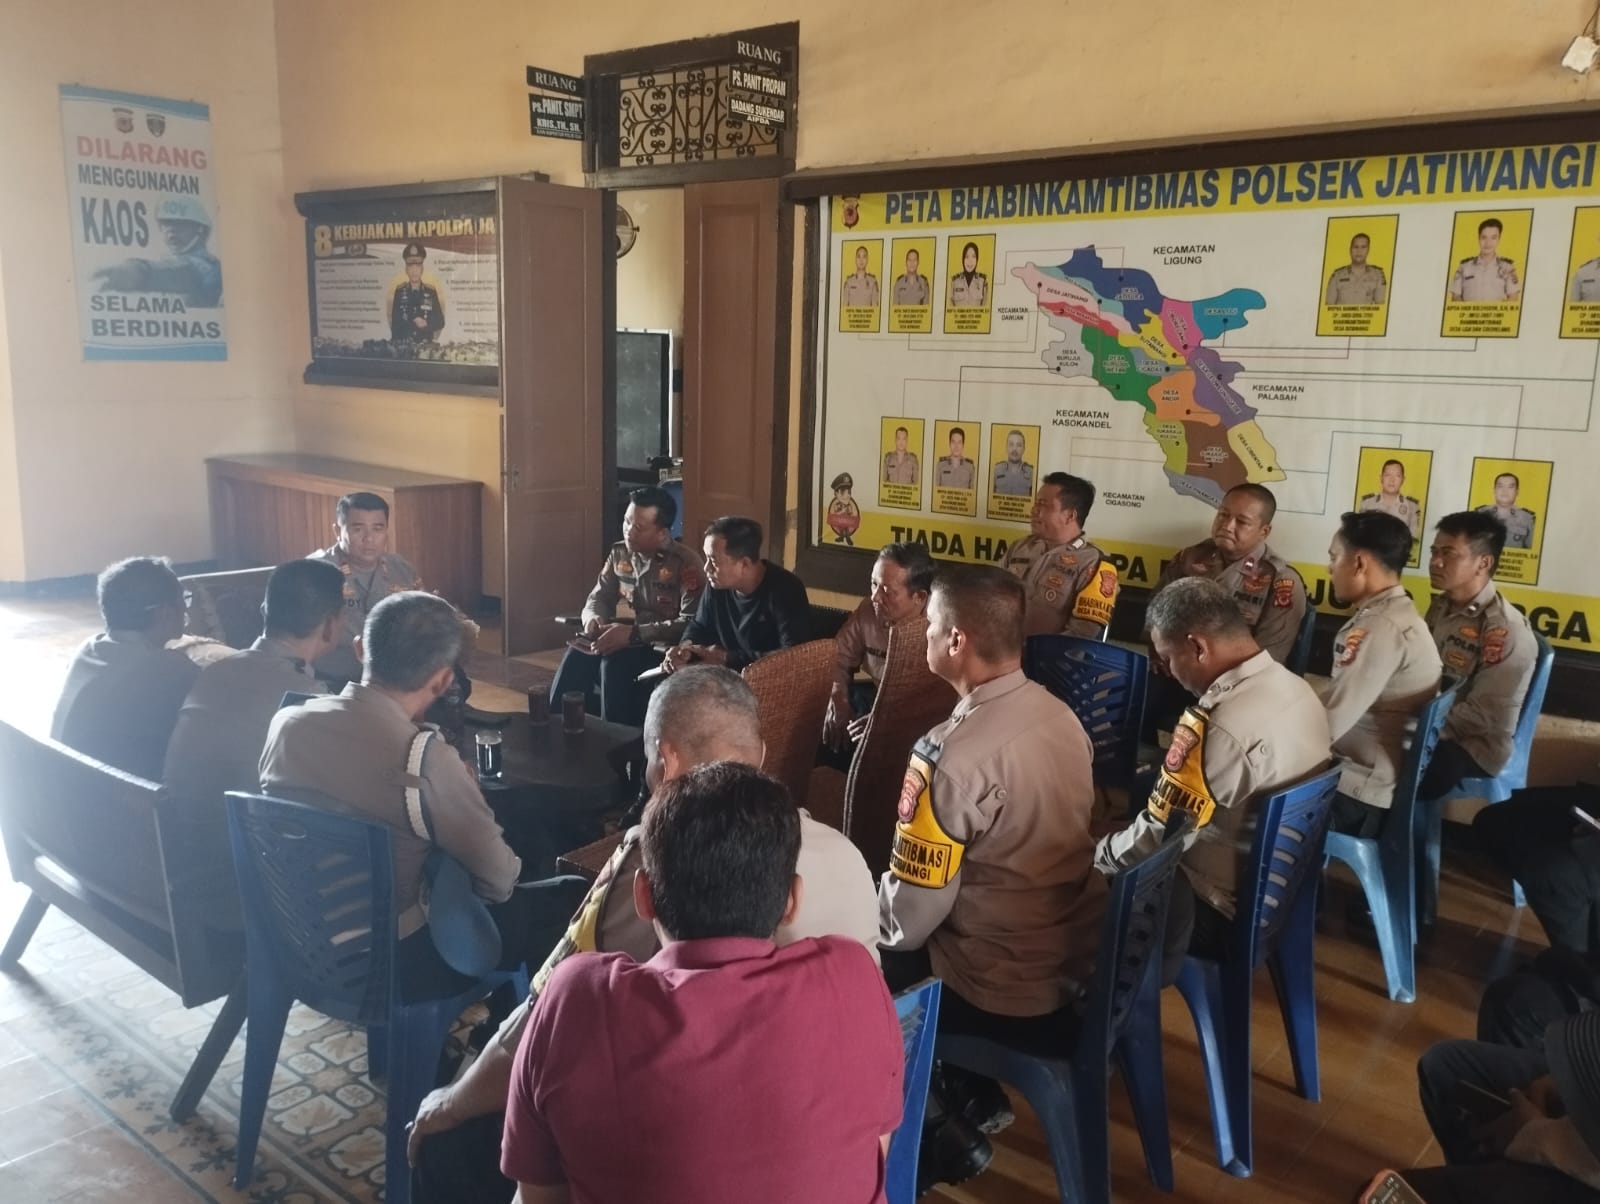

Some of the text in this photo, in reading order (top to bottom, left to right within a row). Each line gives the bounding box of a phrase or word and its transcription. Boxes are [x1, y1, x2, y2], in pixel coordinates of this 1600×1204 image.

[737, 40, 781, 64] RUANG
[535, 71, 577, 92] RUANG
[743, 72, 761, 90] PANIT
[731, 99, 784, 120] DADANG SUKENDAR
[77, 135, 208, 171] DILARANG
[78, 163, 200, 195] MENGGUNAKAN
[885, 144, 1597, 224] PETA BHABINKAMTIBMAS POLSEK JATIWANGI
[80, 196, 149, 248] KAOS
[314, 225, 333, 257] 8
[334, 222, 403, 241] KEBIJAKAN
[407, 218, 473, 238] KAPOLDA
[1153, 244, 1216, 255] KECAMATAN
[1163, 256, 1202, 265] LIGUNG
[90, 295, 186, 314] SELAMA
[91, 318, 221, 339] BERDINAS
[1252, 384, 1304, 392] KECAMATAN
[1257, 393, 1297, 401] PALASAH
[1052, 418, 1112, 429] KASOKANDEL
[1056, 409, 1110, 419] KECAMATAN
[1103, 492, 1145, 501] KECAMATAN
[1105, 499, 1141, 508] CIGASONG
[891, 526, 965, 557] TIADA
